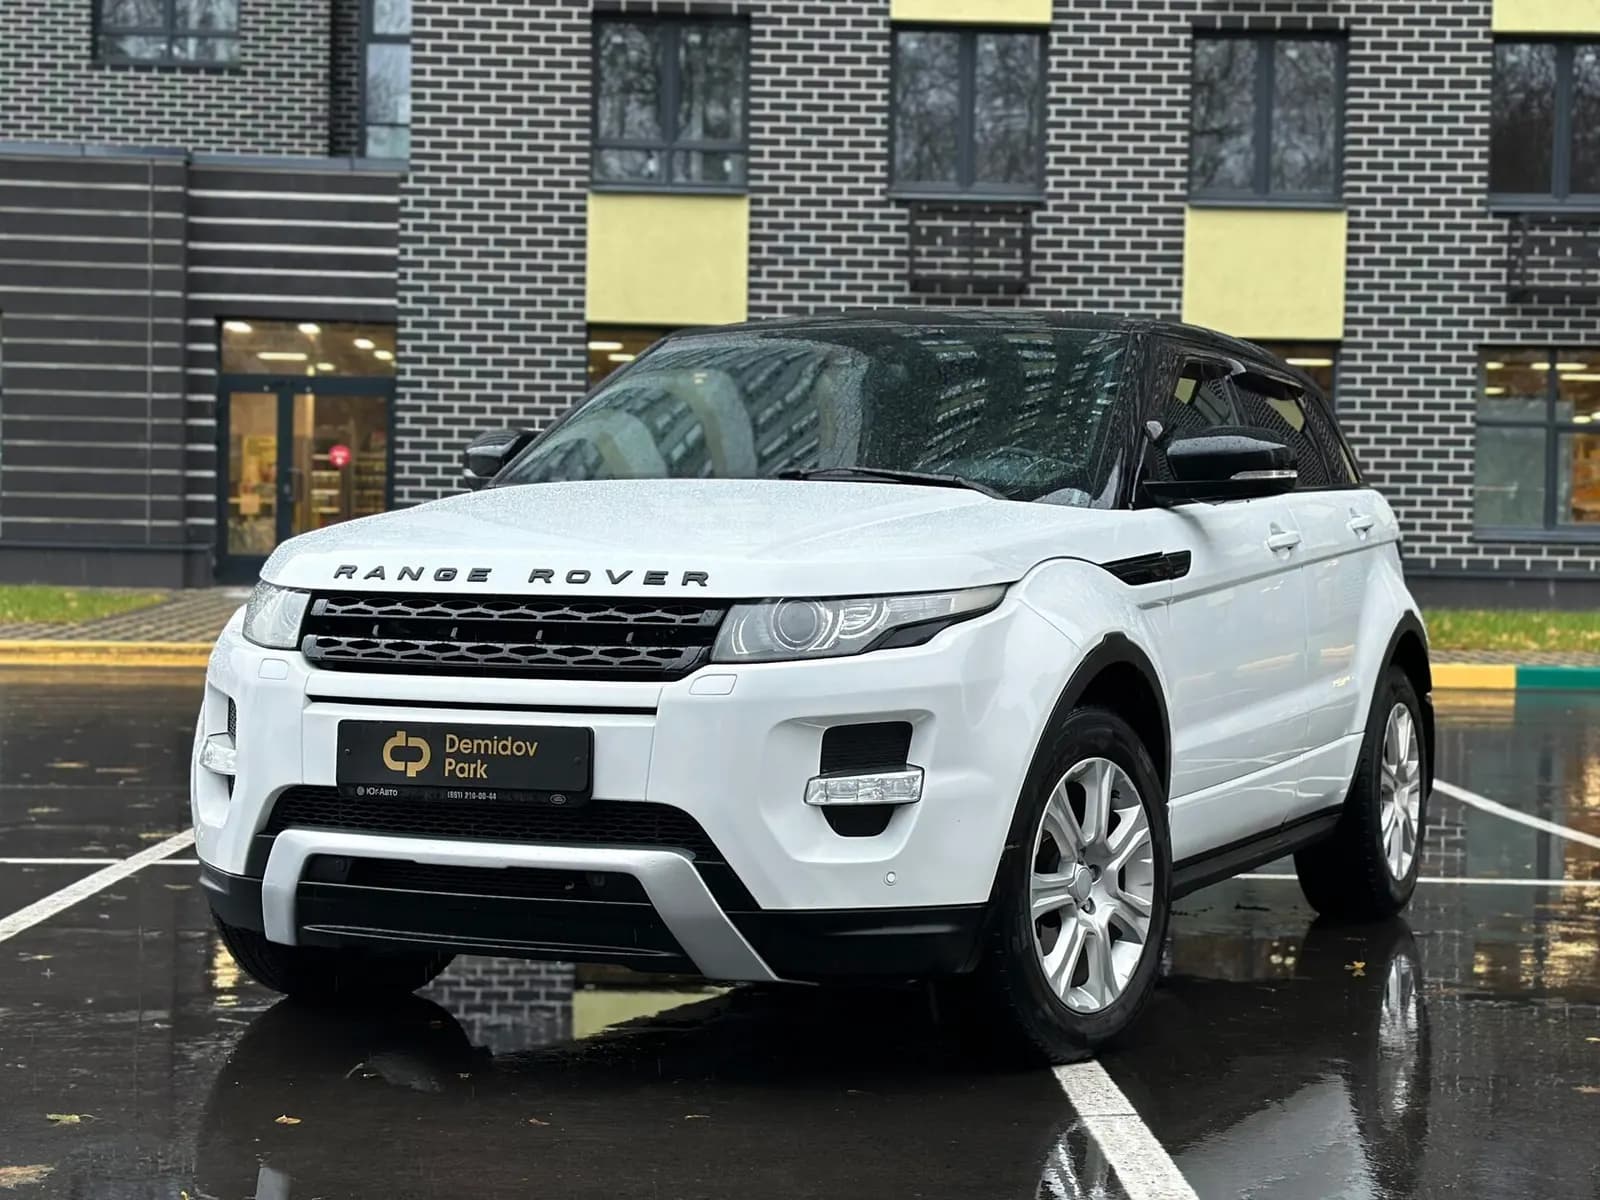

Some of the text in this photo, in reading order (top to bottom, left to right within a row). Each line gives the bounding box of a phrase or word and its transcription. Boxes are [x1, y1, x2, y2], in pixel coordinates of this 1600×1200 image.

[333, 564, 710, 587] RANGE ROVER
[445, 733, 538, 757] Demidov
[444, 758, 488, 779] Park
